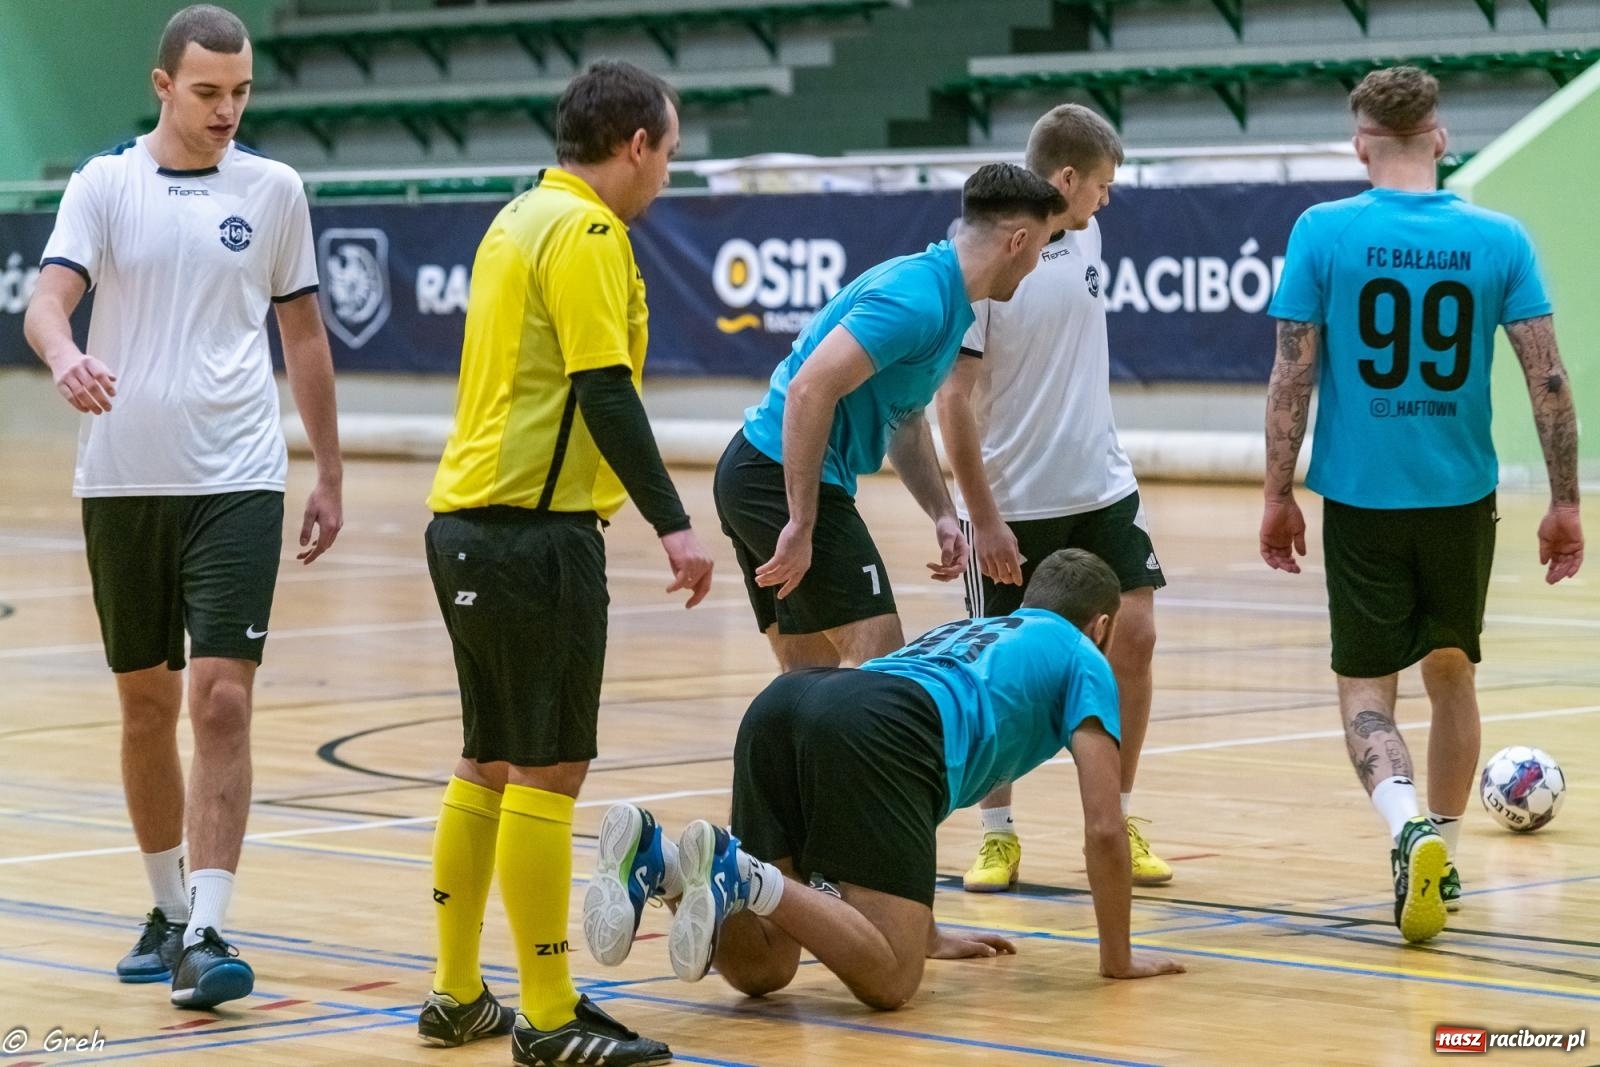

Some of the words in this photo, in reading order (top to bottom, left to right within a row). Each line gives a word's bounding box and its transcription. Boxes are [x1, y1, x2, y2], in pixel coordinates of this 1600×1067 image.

[1366, 246, 1387, 267] FC
[1392, 248, 1471, 271] BAŁAGAN
[1358, 277, 1474, 392] 99
[1487, 793, 1525, 824] SELECT
